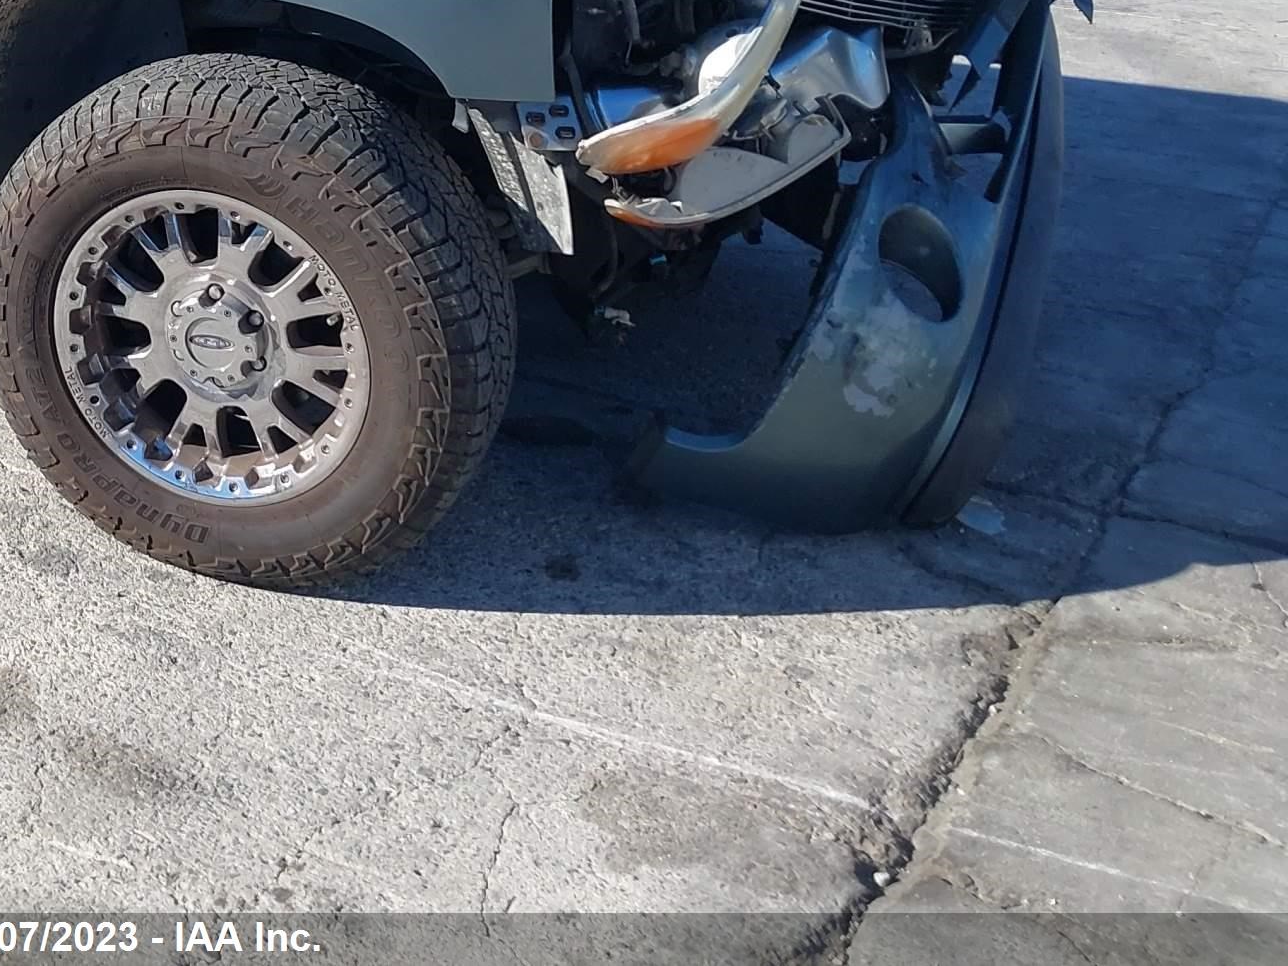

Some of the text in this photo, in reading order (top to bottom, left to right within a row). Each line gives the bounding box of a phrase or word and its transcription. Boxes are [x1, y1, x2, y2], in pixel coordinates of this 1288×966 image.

[310, 255, 358, 332] MOTO METAL
[65, 366, 109, 439] MOTO METAL
